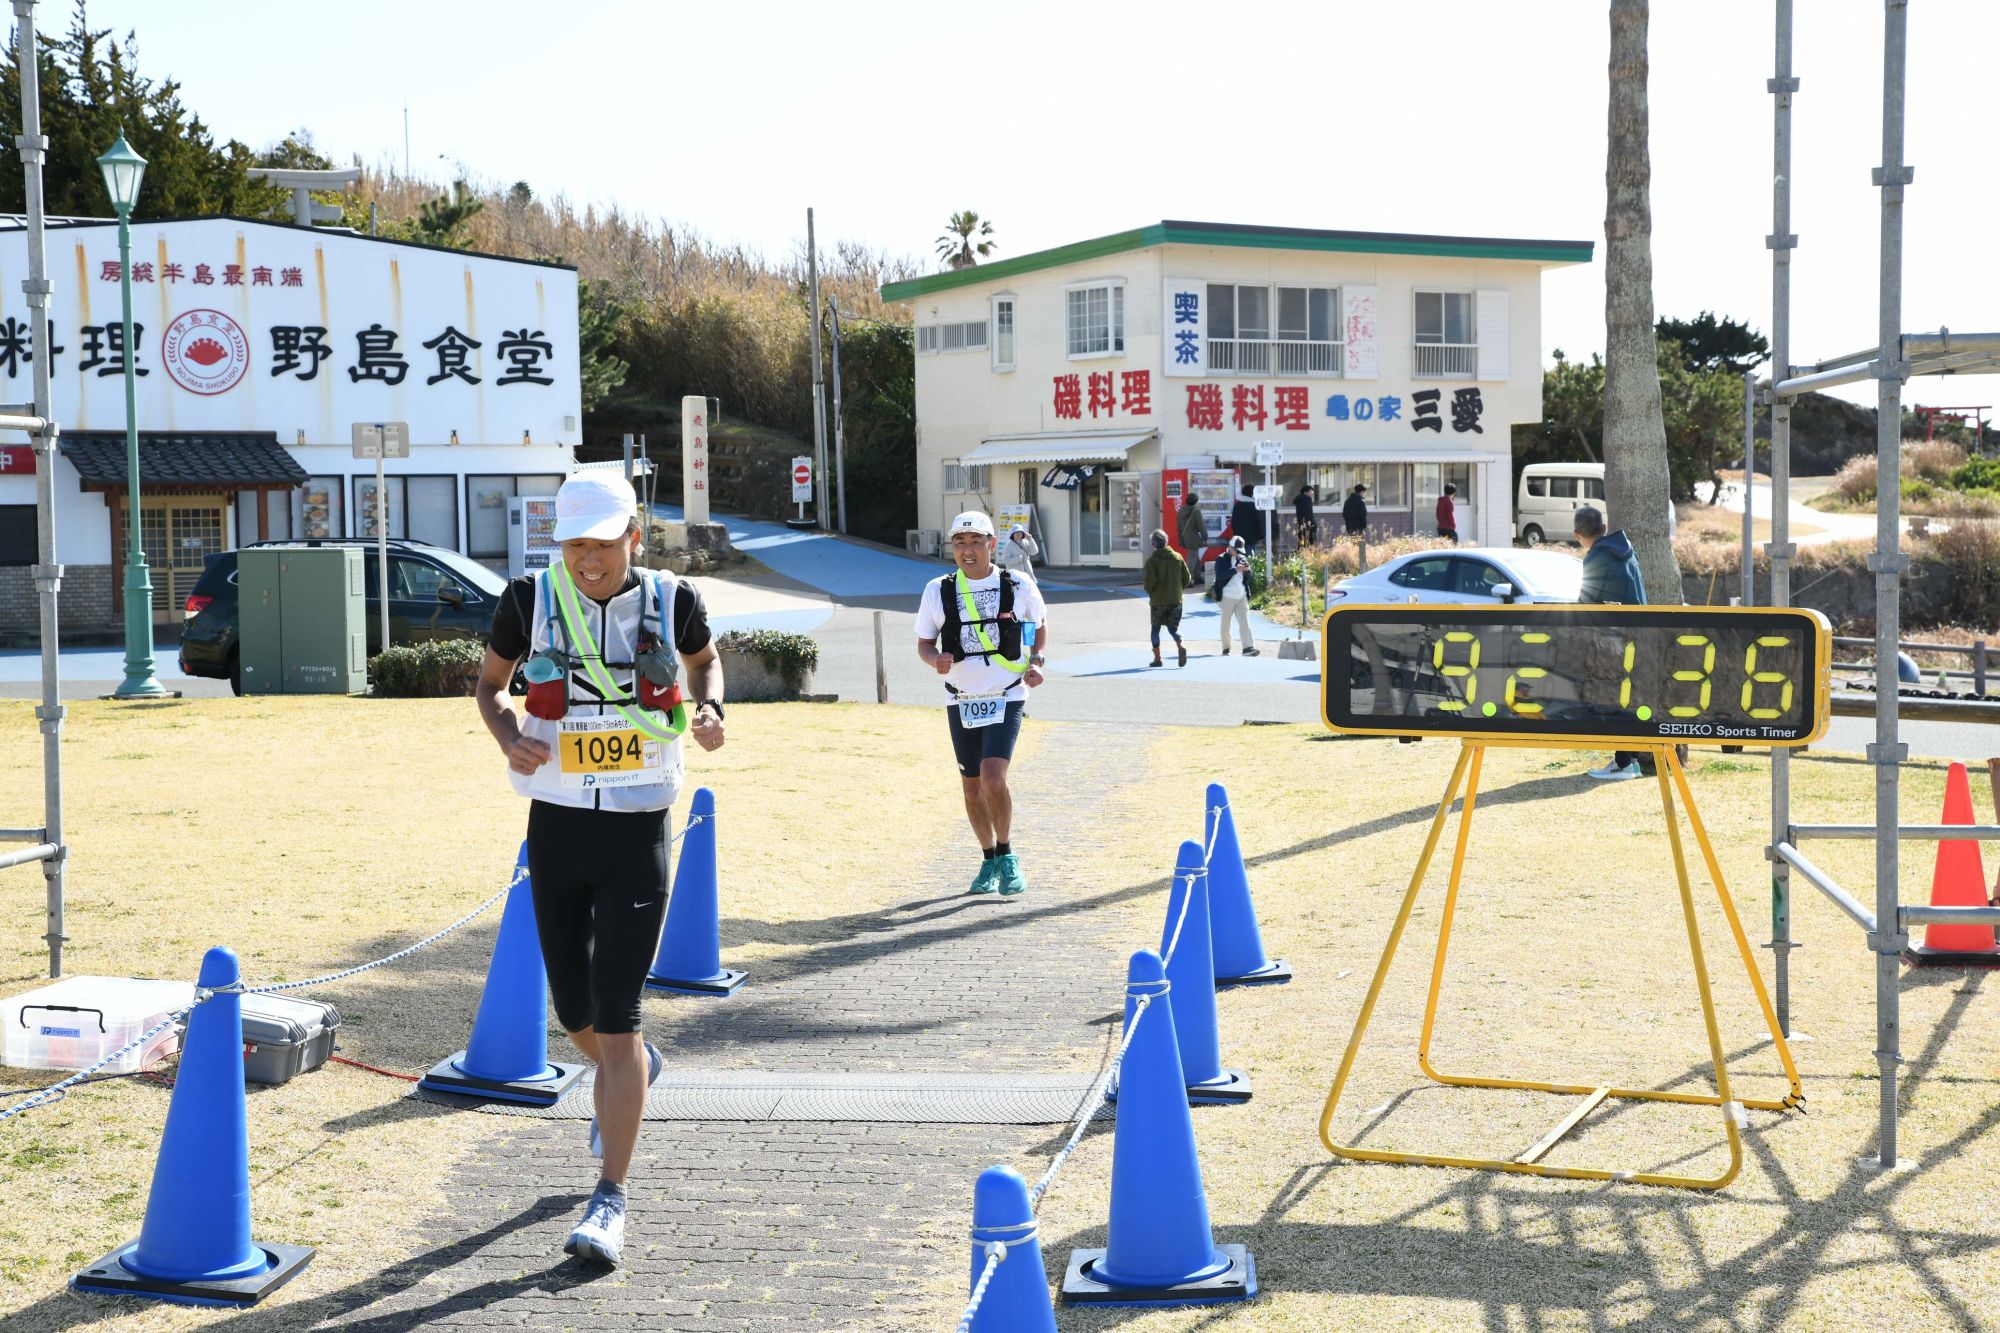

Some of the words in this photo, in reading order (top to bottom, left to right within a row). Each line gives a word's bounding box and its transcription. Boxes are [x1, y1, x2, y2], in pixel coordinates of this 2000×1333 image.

[100, 261, 304, 287] 房総半島最南端
[1174, 291, 1199, 365] 喫茶
[270, 323, 554, 386] 野島食堂
[1053, 369, 1151, 420] 磯料理
[1186, 384, 1310, 432] 磯料理
[1326, 394, 1401, 422] 亀の家
[1411, 386, 1484, 435] 三愛
[963, 701, 997, 717] 7092
[1659, 723, 1712, 736] SEIKO
[1716, 725, 1757, 737] Sports
[1761, 726, 1797, 738] Timer
[574, 734, 641, 764] 1094
[598, 775, 628, 784] nippon
